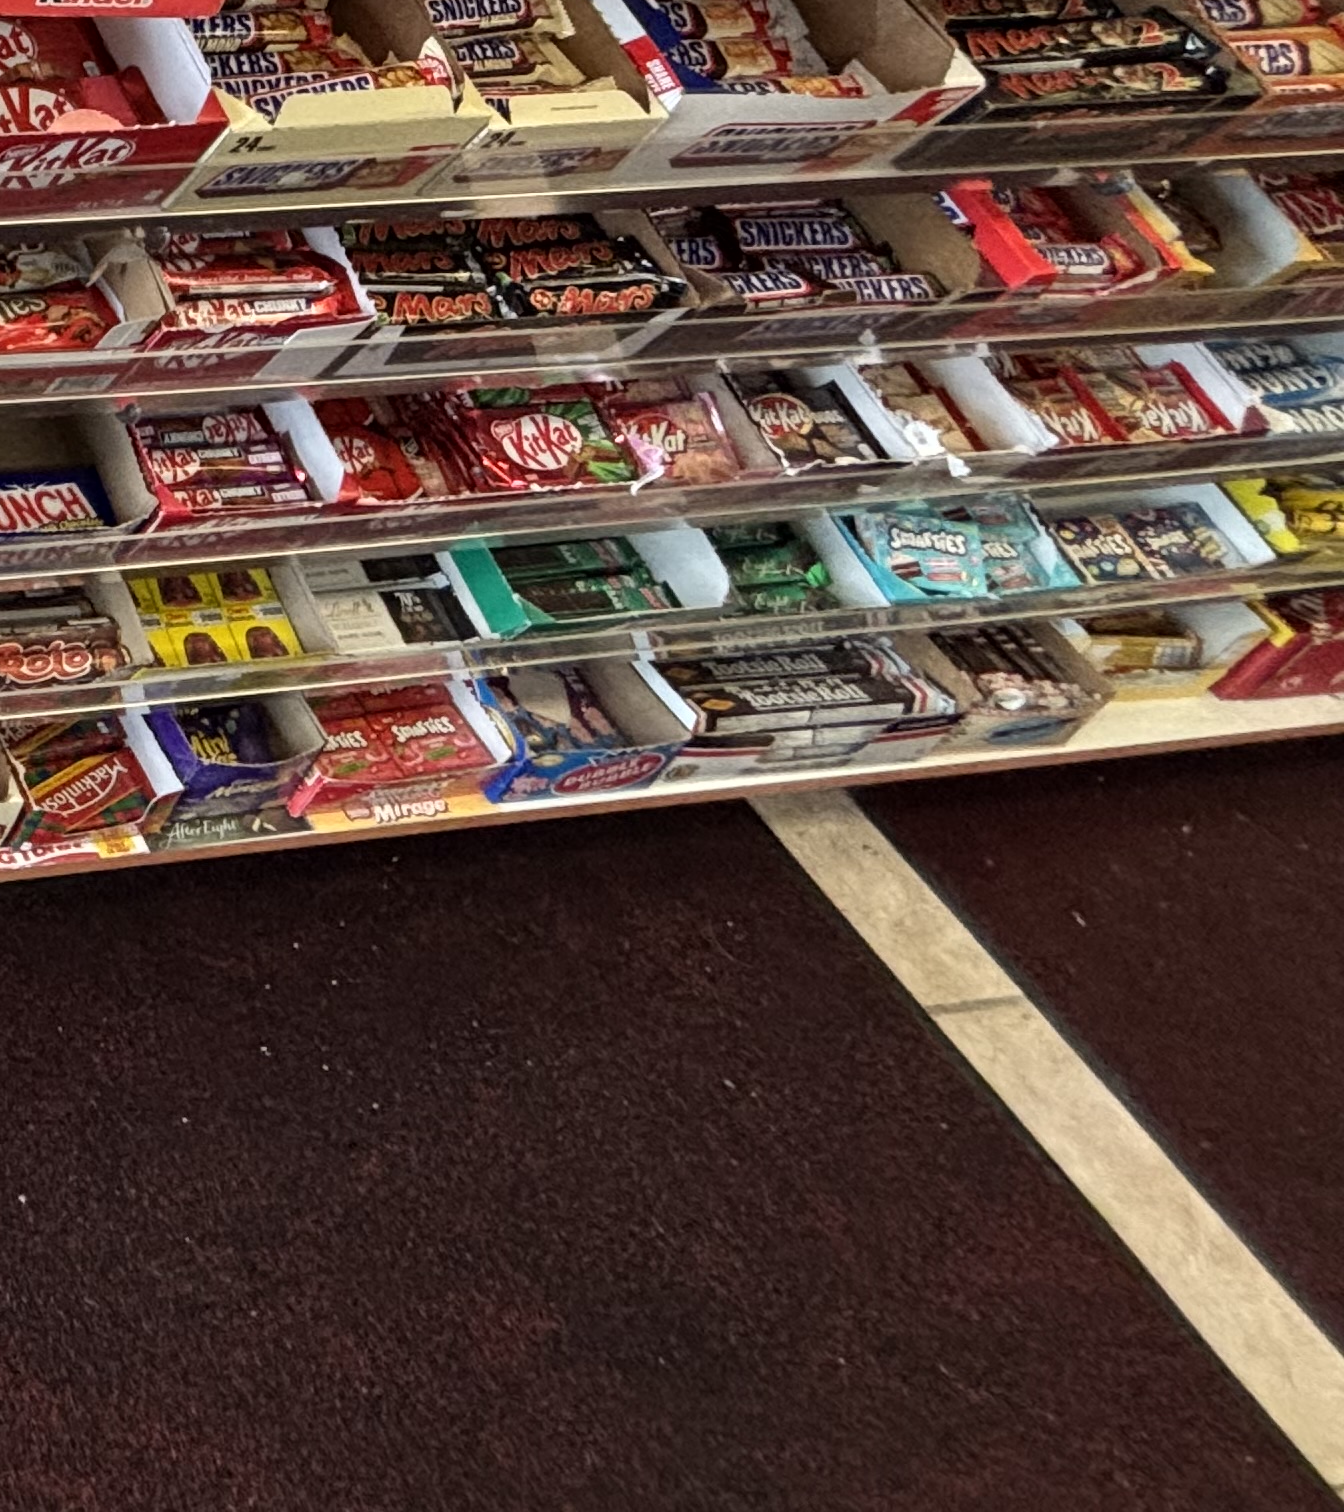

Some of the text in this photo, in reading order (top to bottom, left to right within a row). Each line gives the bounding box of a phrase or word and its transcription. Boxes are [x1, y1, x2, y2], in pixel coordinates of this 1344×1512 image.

[229, 136, 259, 152] 24
[481, 132, 513, 148] 24
[740, 220, 849, 247] SNICKERS
[511, 242, 613, 281] Mars
[394, 293, 492, 323] Mars
[507, 414, 579, 469] KitKat
[890, 528, 965, 554] SMARTIES
[701, 653, 826, 675] Tootsie Roll
[724, 683, 867, 707] Tootsie Roll
[391, 716, 456, 743] SMARTIES
[373, 797, 448, 823] Mirage
[169, 821, 201, 839] After
